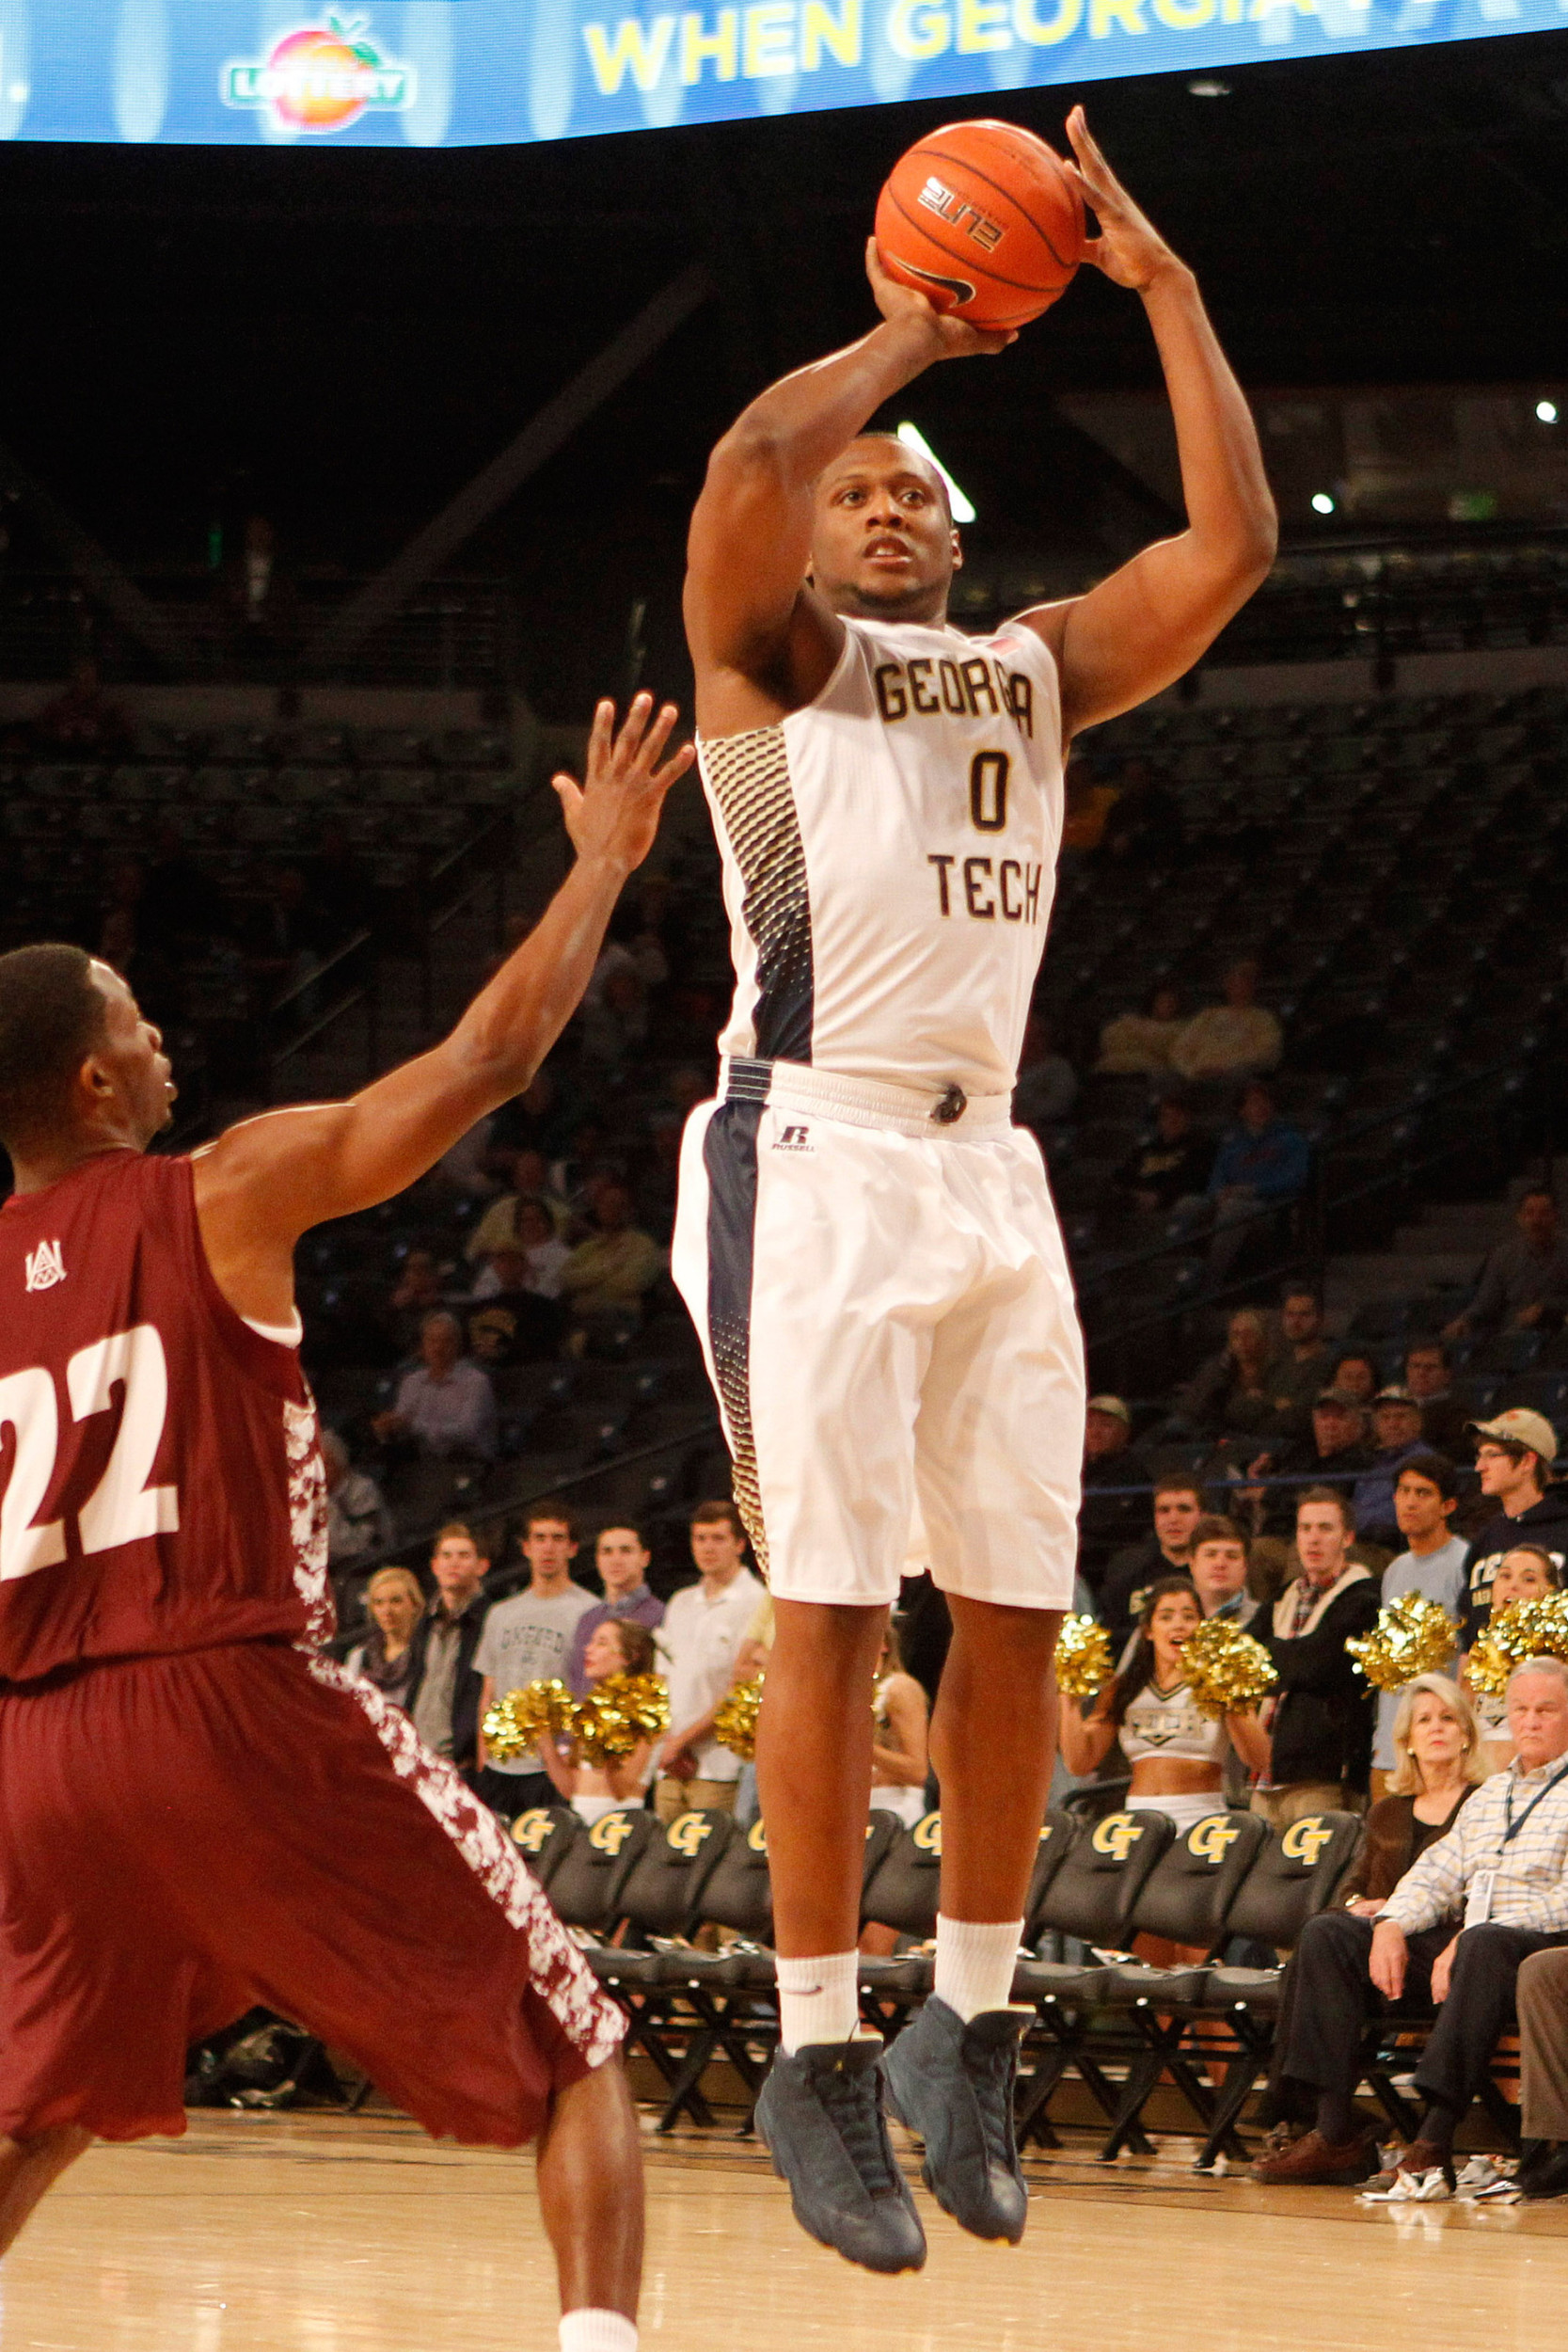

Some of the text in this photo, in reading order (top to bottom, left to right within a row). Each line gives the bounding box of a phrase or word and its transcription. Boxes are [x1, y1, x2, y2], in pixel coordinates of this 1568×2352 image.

[584, 0, 861, 95] WHEN
[917, 176, 1006, 253] ELITE
[970, 749, 1011, 835] 0
[927, 853, 1042, 925] TECH
[0, 1323, 180, 1581] 22
[589, 1811, 633, 1856] GT
[666, 1811, 712, 1857] GT
[1092, 1814, 1144, 1861] GT
[1187, 1815, 1241, 1864] GT
[1281, 1816, 1334, 1866] GT
